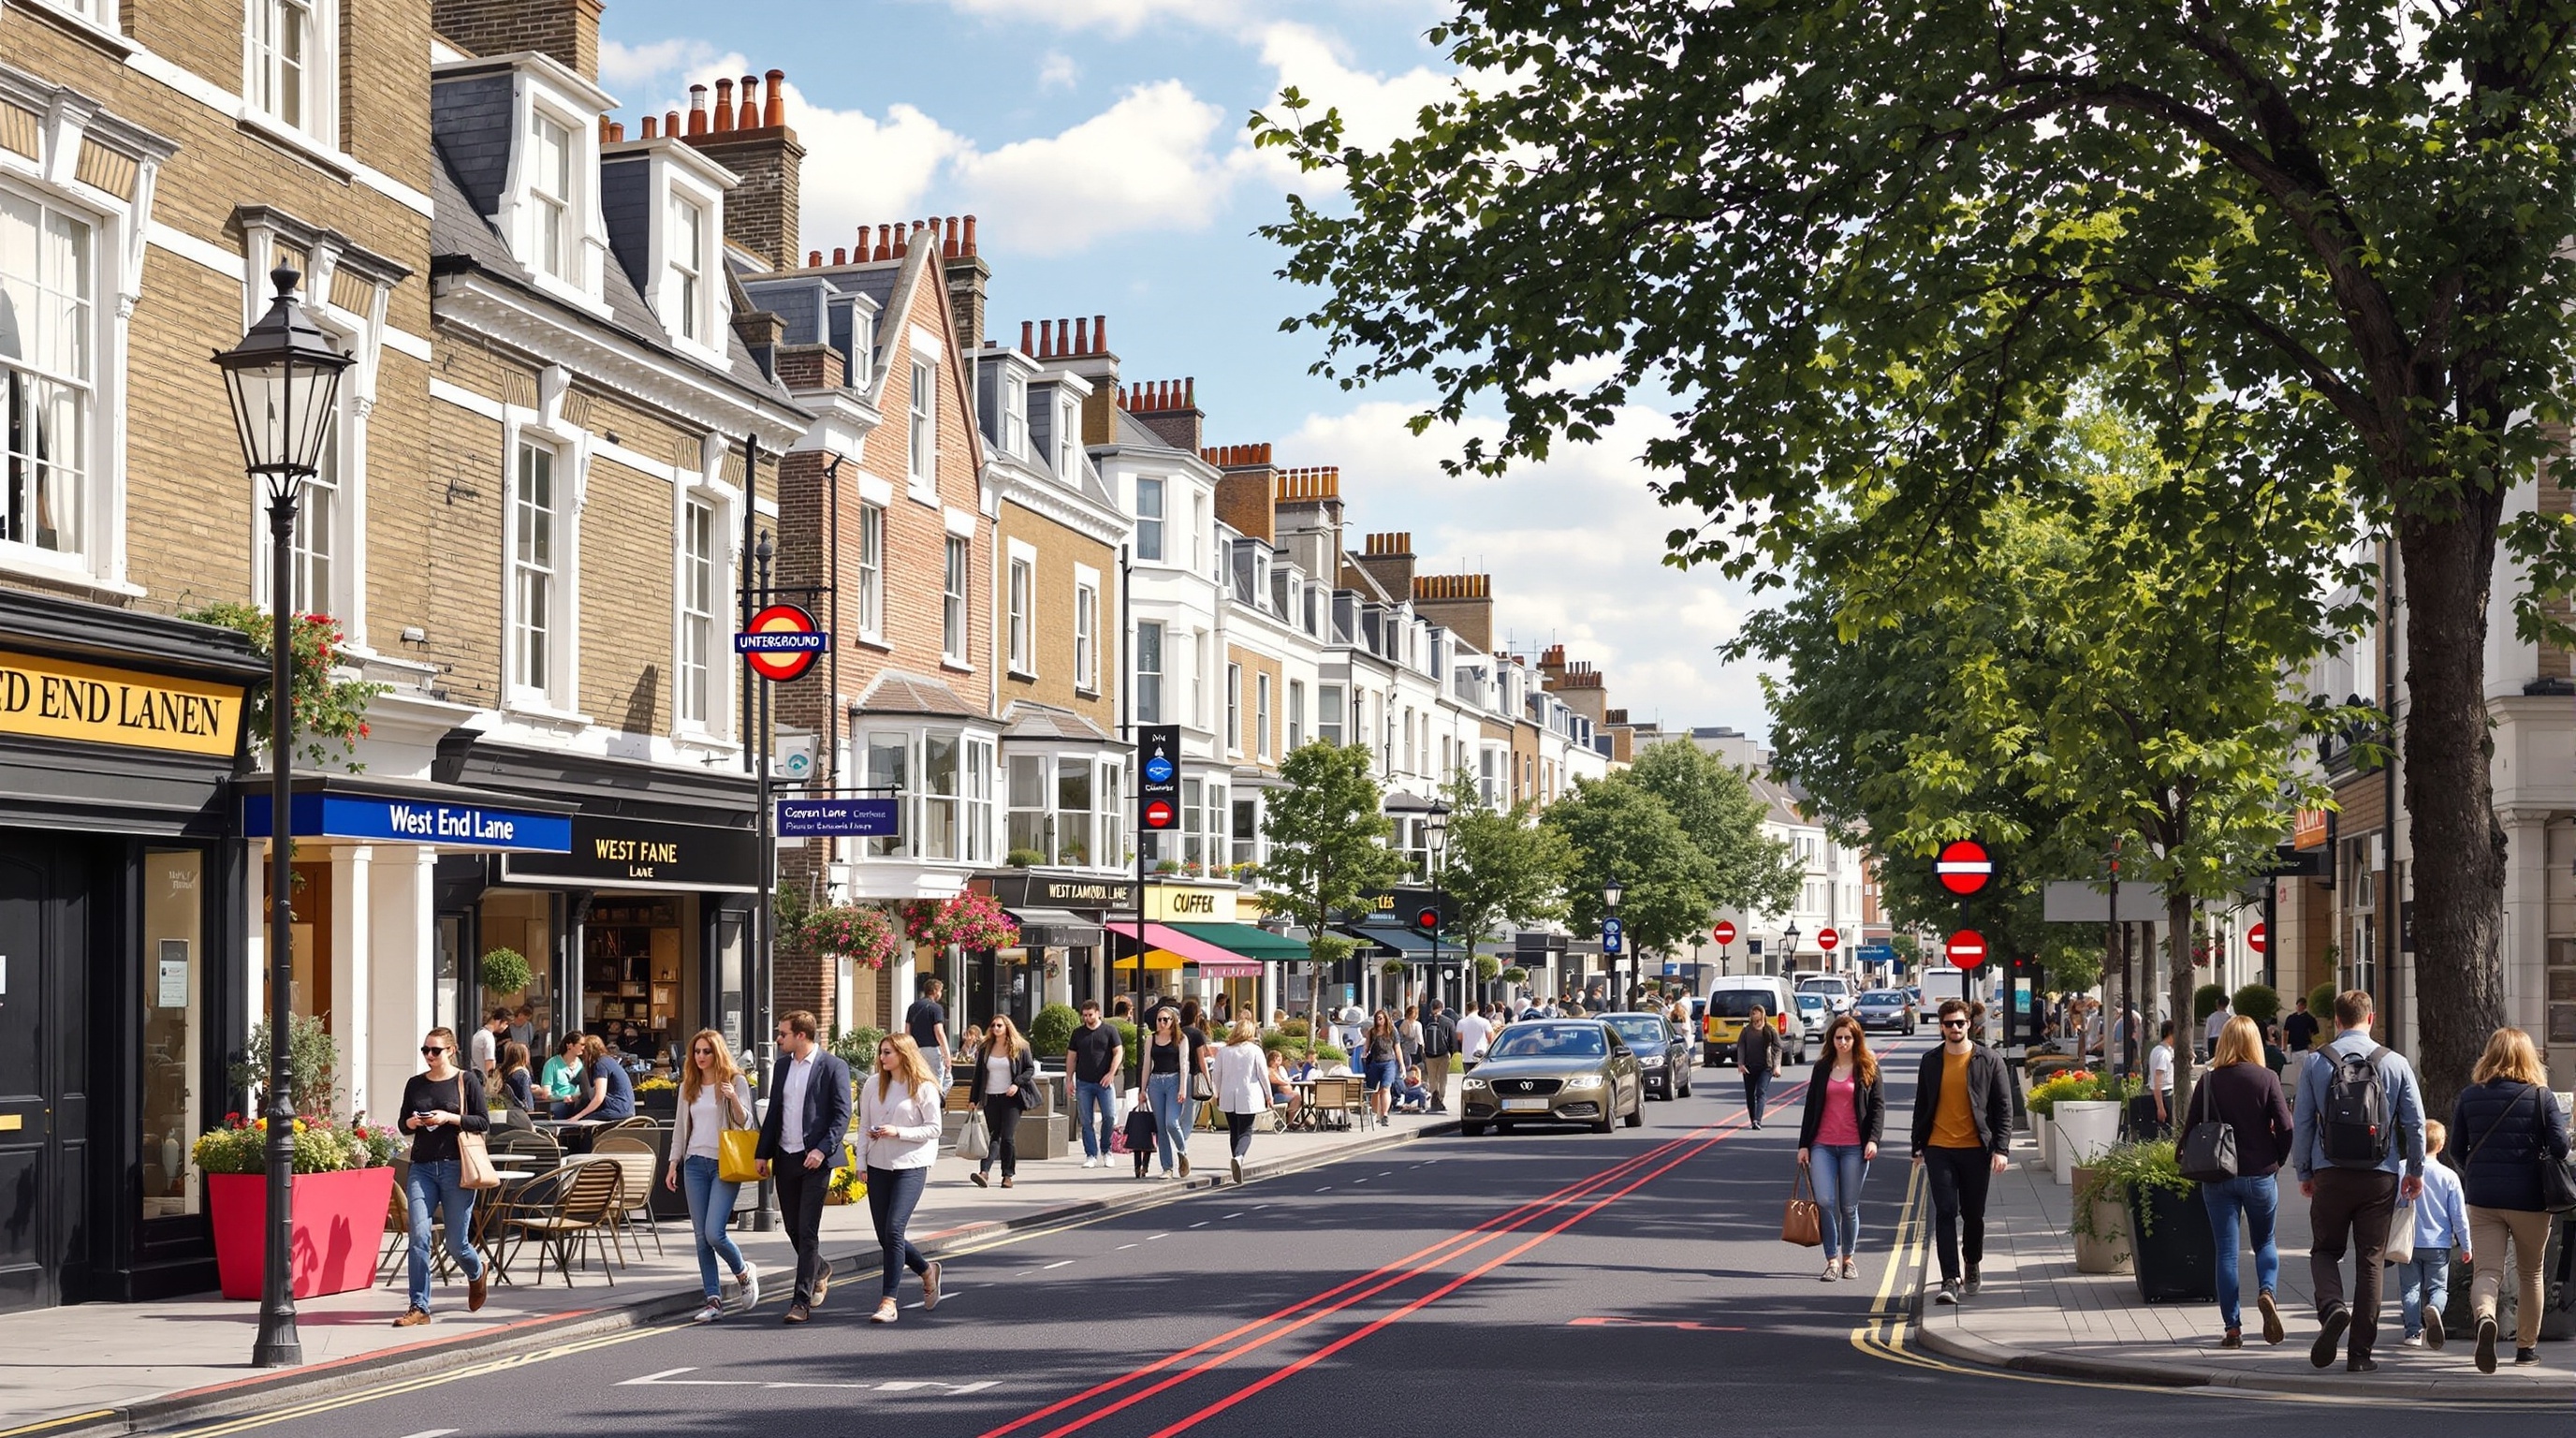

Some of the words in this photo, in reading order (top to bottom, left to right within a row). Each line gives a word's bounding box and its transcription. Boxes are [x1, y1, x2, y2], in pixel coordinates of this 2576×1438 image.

[38, 676, 110, 723] END
[118, 686, 222, 737] LANEN
[389, 804, 432, 835] West
[438, 808, 471, 837] End
[475, 811, 514, 840] Lane
[595, 839, 636, 860] WEST
[640, 842, 678, 863] FANE
[1048, 884, 1069, 899] WEST
